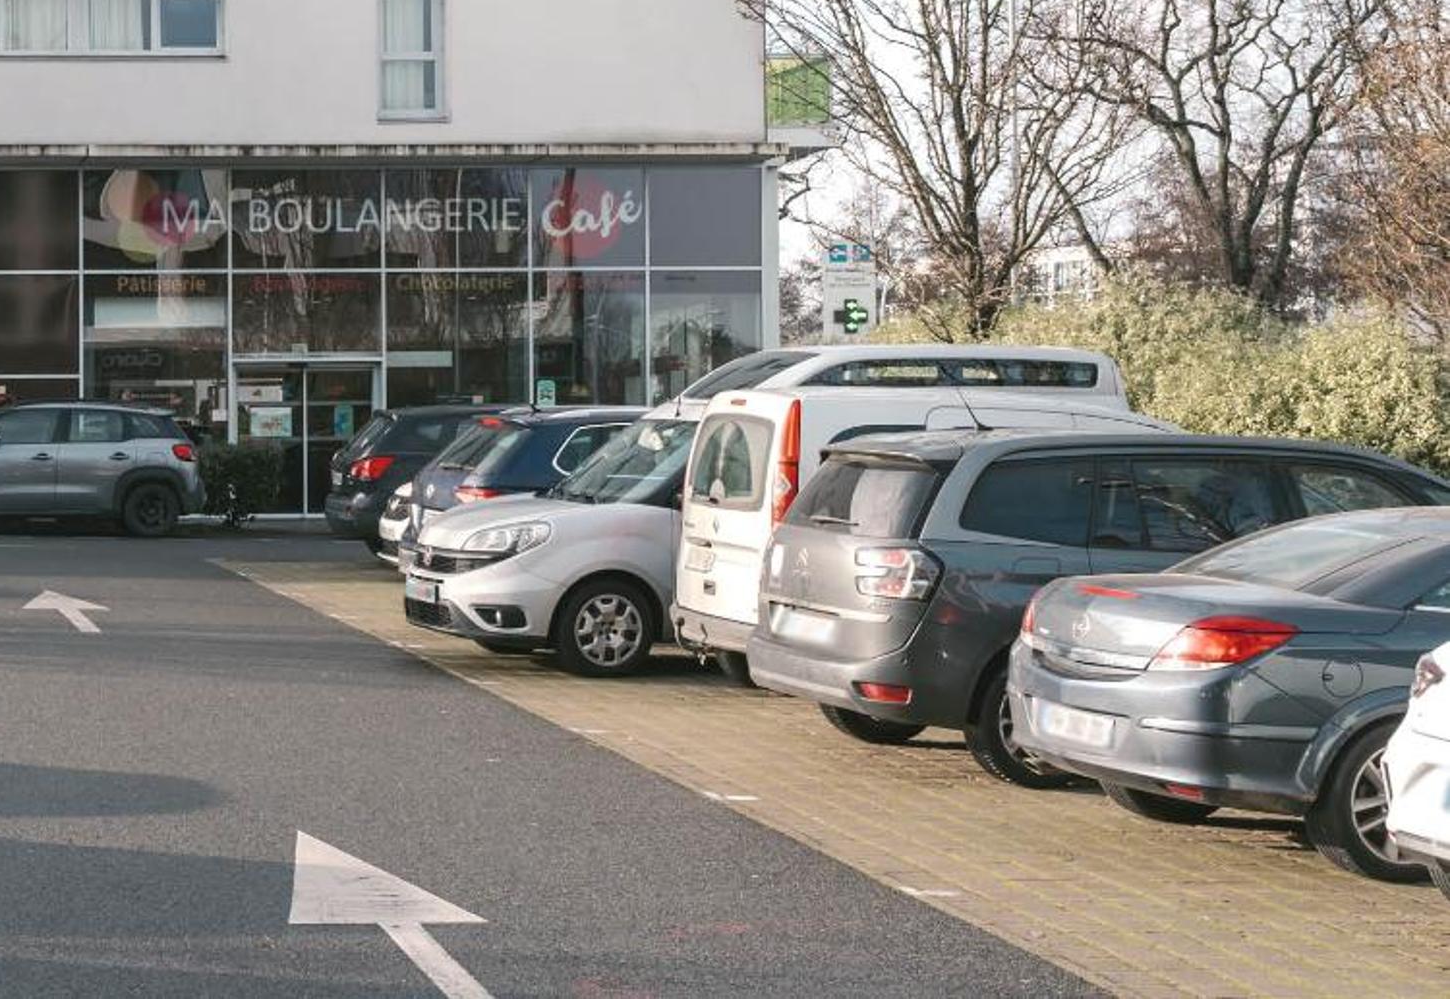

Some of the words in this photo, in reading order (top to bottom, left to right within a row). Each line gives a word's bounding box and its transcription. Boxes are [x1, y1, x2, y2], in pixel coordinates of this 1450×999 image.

[161, 198, 227, 234] MA
[249, 197, 522, 234] BOULANGERIE
[541, 190, 642, 238] Café
[117, 275, 207, 293] Pâtisserie
